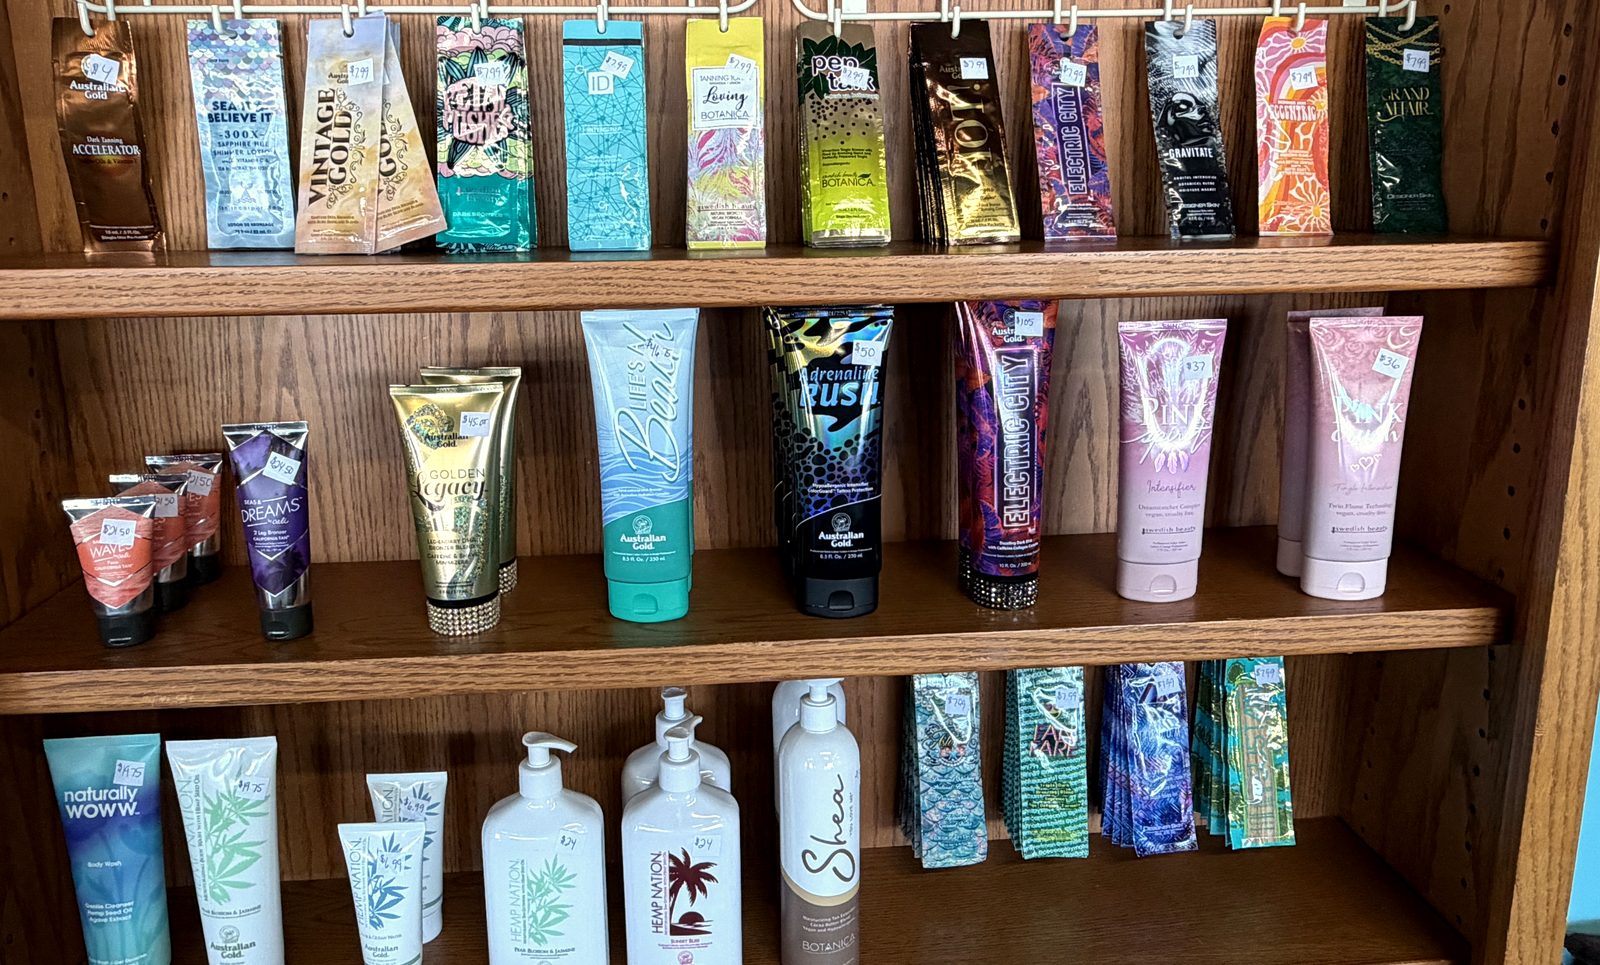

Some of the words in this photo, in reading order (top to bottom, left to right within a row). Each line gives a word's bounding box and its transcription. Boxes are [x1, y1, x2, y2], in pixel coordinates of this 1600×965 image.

[91, 62, 113, 81] $4
[591, 75, 610, 92] ID
[84, 90, 108, 100] Gold
[702, 86, 749, 111] Loving
[1381, 87, 1430, 100] GRAND
[212, 100, 237, 111] SEA
[1057, 87, 1079, 123] CITY
[1382, 101, 1434, 117] AFFAIR
[207, 113, 257, 123] BELIEVE
[260, 112, 272, 122] IT
[701, 110, 750, 119] BOTANICA
[101, 136, 123, 144] Tanning
[308, 88, 336, 206] VINTAGE
[328, 110, 352, 185] GOLD
[72, 144, 141, 156] ACCELERATOR
[1168, 147, 1214, 158] GRAVITATE
[1062, 126, 1088, 195] ELECTRIC
[822, 178, 875, 188] BOTANICA
[854, 342, 876, 358] $50
[1186, 361, 1206, 372] $37
[1379, 354, 1400, 370] $36
[799, 366, 880, 381] Adrenaline
[1001, 355, 1030, 412] CITY
[424, 432, 469, 441] Australian
[436, 440, 456, 448] Gold
[429, 468, 485, 480] GOLDEN
[1003, 417, 1030, 527] ELECTRIC
[240, 498, 301, 523] DREAMS
[620, 533, 667, 542] Australian
[818, 531, 865, 540] Australian
[632, 542, 653, 550] Gold
[64, 785, 138, 803] naturally
[801, 774, 856, 882] Shea
[560, 835, 577, 850] $24
[694, 837, 713, 850] $24
[349, 840, 361, 890] NATION
[508, 859, 520, 906] NATION
[650, 851, 663, 899] NATION
[510, 908, 521, 942] HEMP
[651, 901, 664, 934] HEMP
[210, 941, 256, 951] Australian
[365, 944, 399, 952] Australian
[802, 933, 856, 951] BOTANICA
[220, 951, 242, 959] Gold
